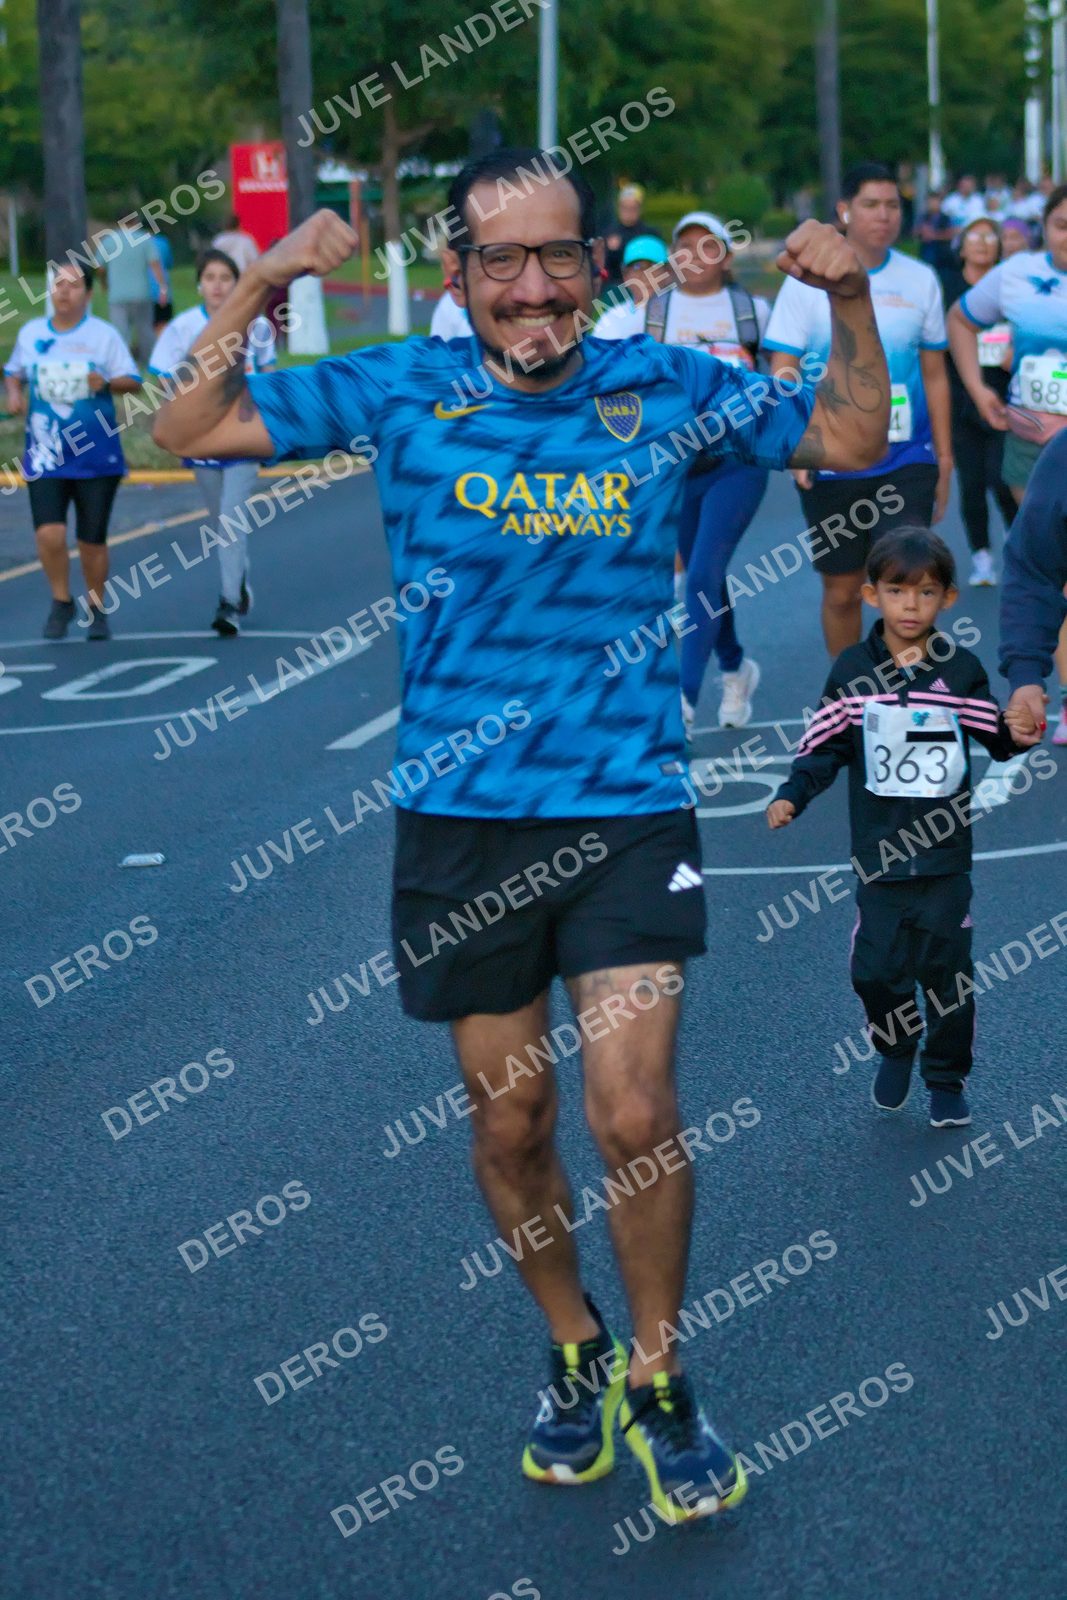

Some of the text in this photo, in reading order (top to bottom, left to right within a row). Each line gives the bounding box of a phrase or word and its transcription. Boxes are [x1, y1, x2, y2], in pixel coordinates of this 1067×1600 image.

[1030, 379, 1067, 406] 88
[603, 405, 637, 417] CABJ
[454, 472, 631, 519] QATAR
[501, 513, 632, 537] AIRWAYS
[874, 744, 948, 785] 363
